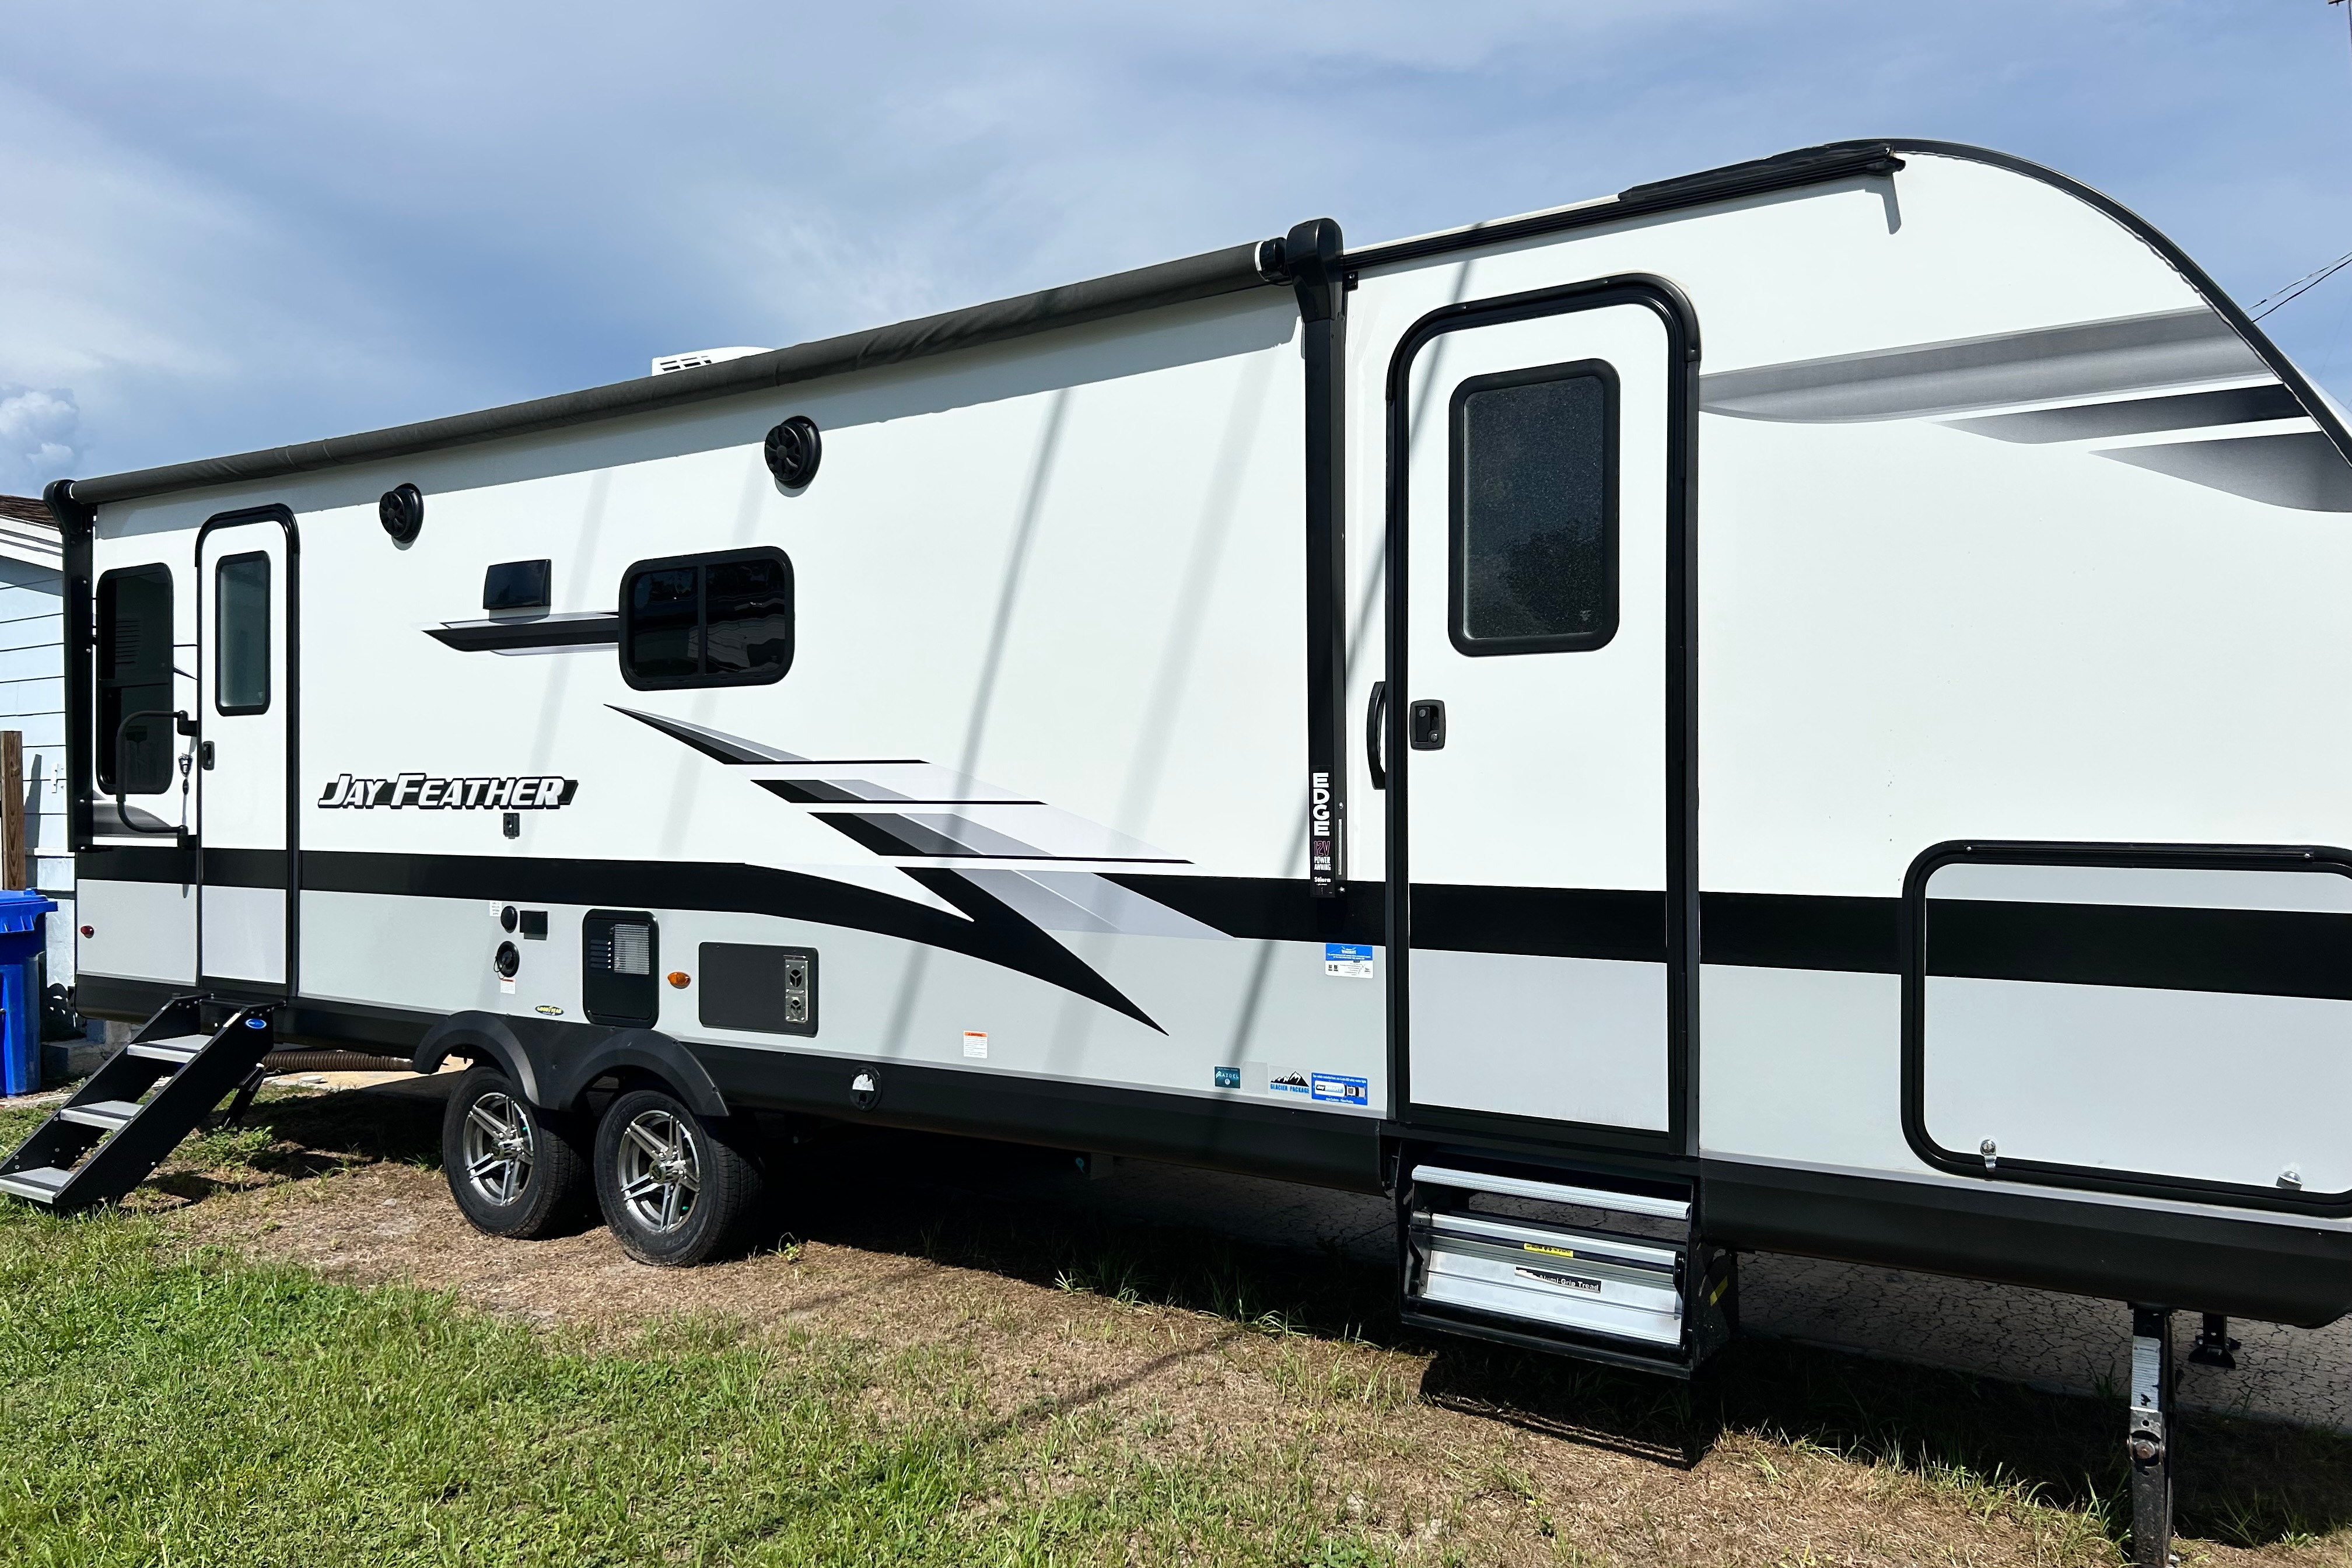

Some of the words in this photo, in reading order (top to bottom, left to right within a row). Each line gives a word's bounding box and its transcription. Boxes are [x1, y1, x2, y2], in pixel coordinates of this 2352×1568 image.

[318, 774, 387, 809] JAY
[390, 773, 565, 809] FEATHER
[1312, 772, 1330, 836] EDGE
[1314, 841, 1331, 856] 12V
[1270, 1083, 1288, 1091] GLACIER
[1290, 1086, 1310, 1094] PACKAGE
[1577, 1280, 1599, 1290] Tread
